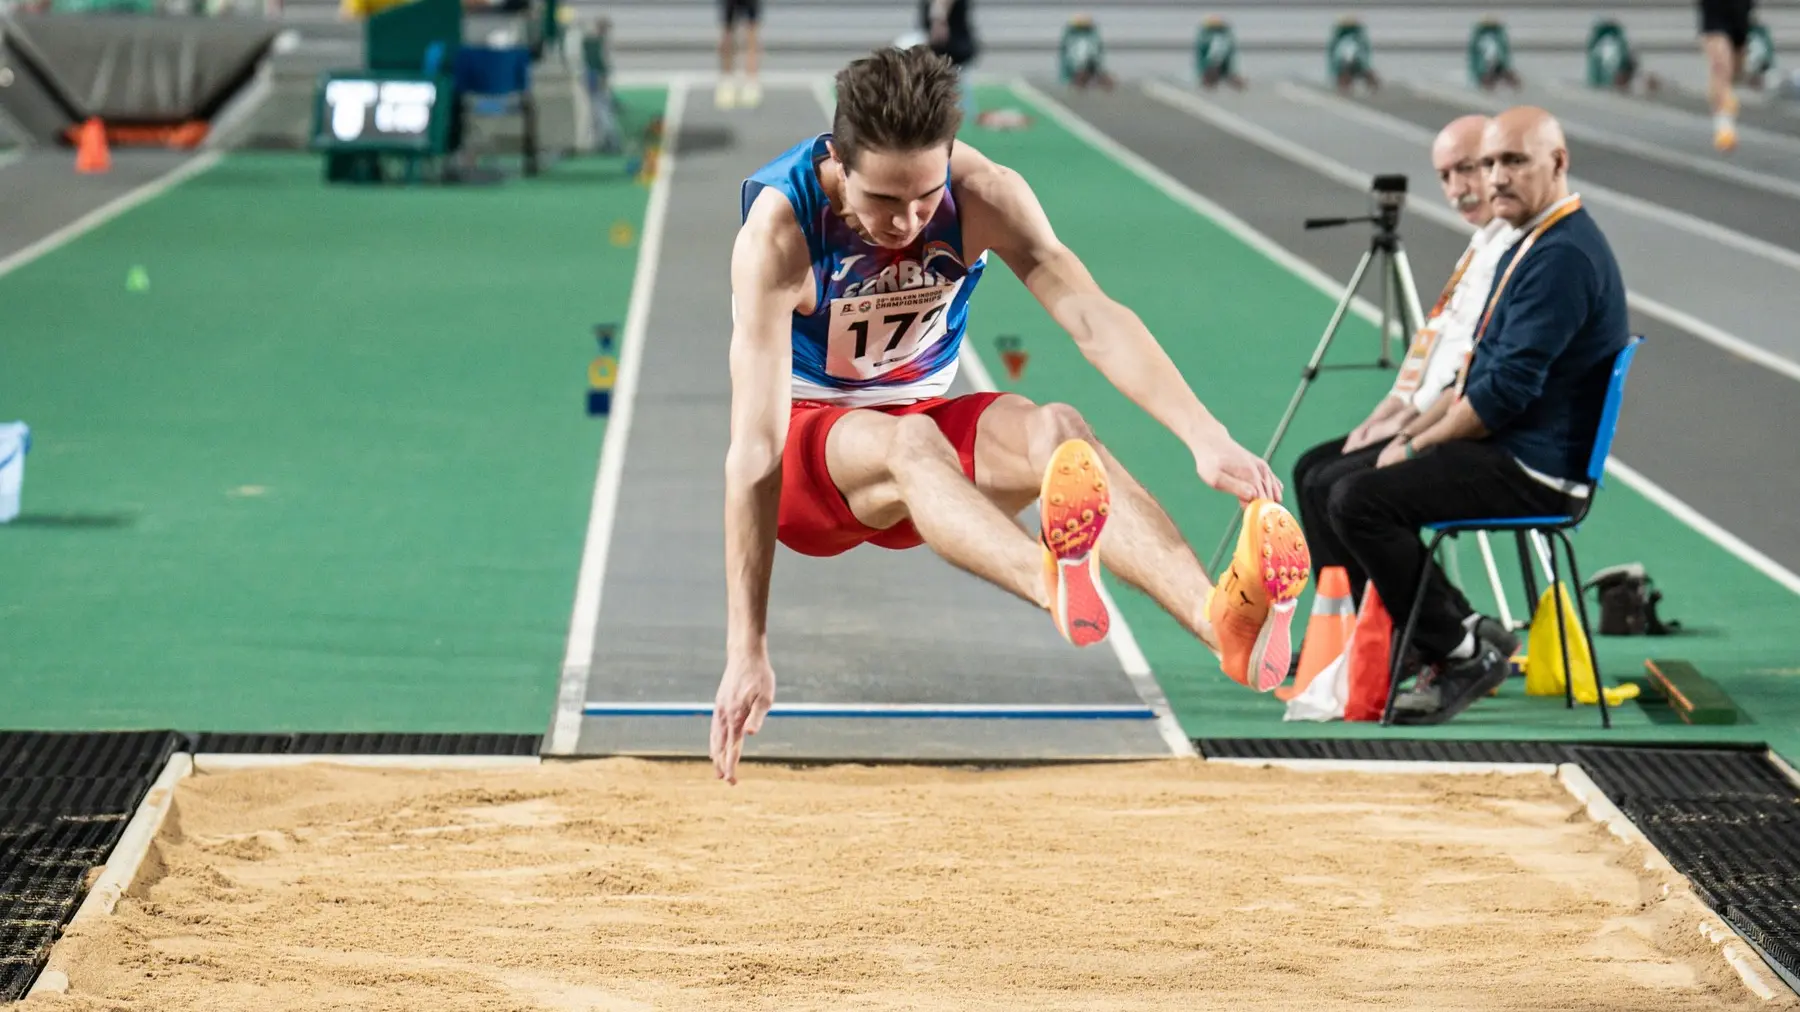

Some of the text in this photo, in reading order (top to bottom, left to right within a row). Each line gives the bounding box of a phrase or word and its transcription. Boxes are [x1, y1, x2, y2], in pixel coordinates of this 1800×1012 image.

[875, 295, 942, 310] CHAMPIONSHIPS
[890, 293, 917, 302] BALKAN
[918, 290, 943, 298] INDOOR
